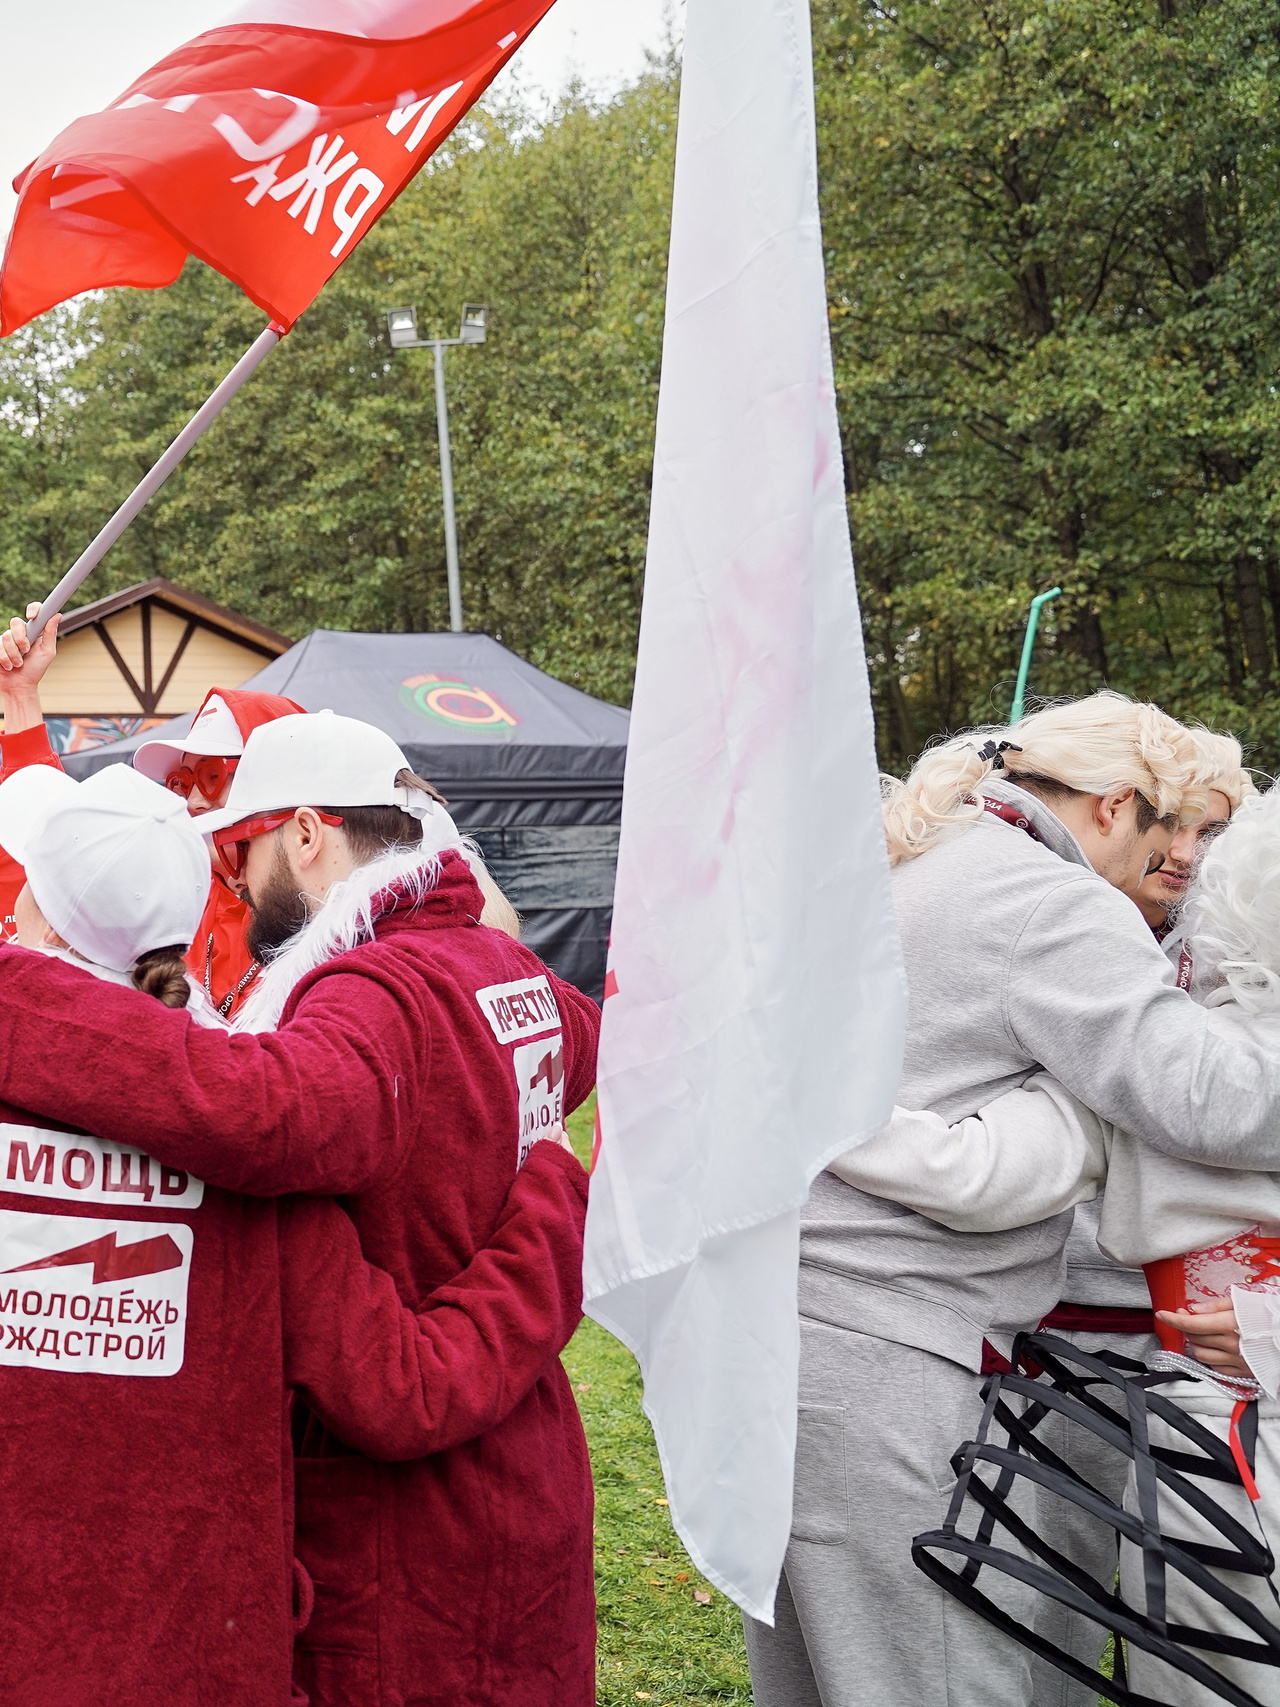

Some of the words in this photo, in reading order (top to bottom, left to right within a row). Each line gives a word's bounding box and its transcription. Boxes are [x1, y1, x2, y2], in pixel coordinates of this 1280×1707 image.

[4, 914, 17, 924] ЛЕ
[1180, 961, 1191, 988] ОРОДА
[6, 1140, 189, 1202] МОЩЬ
